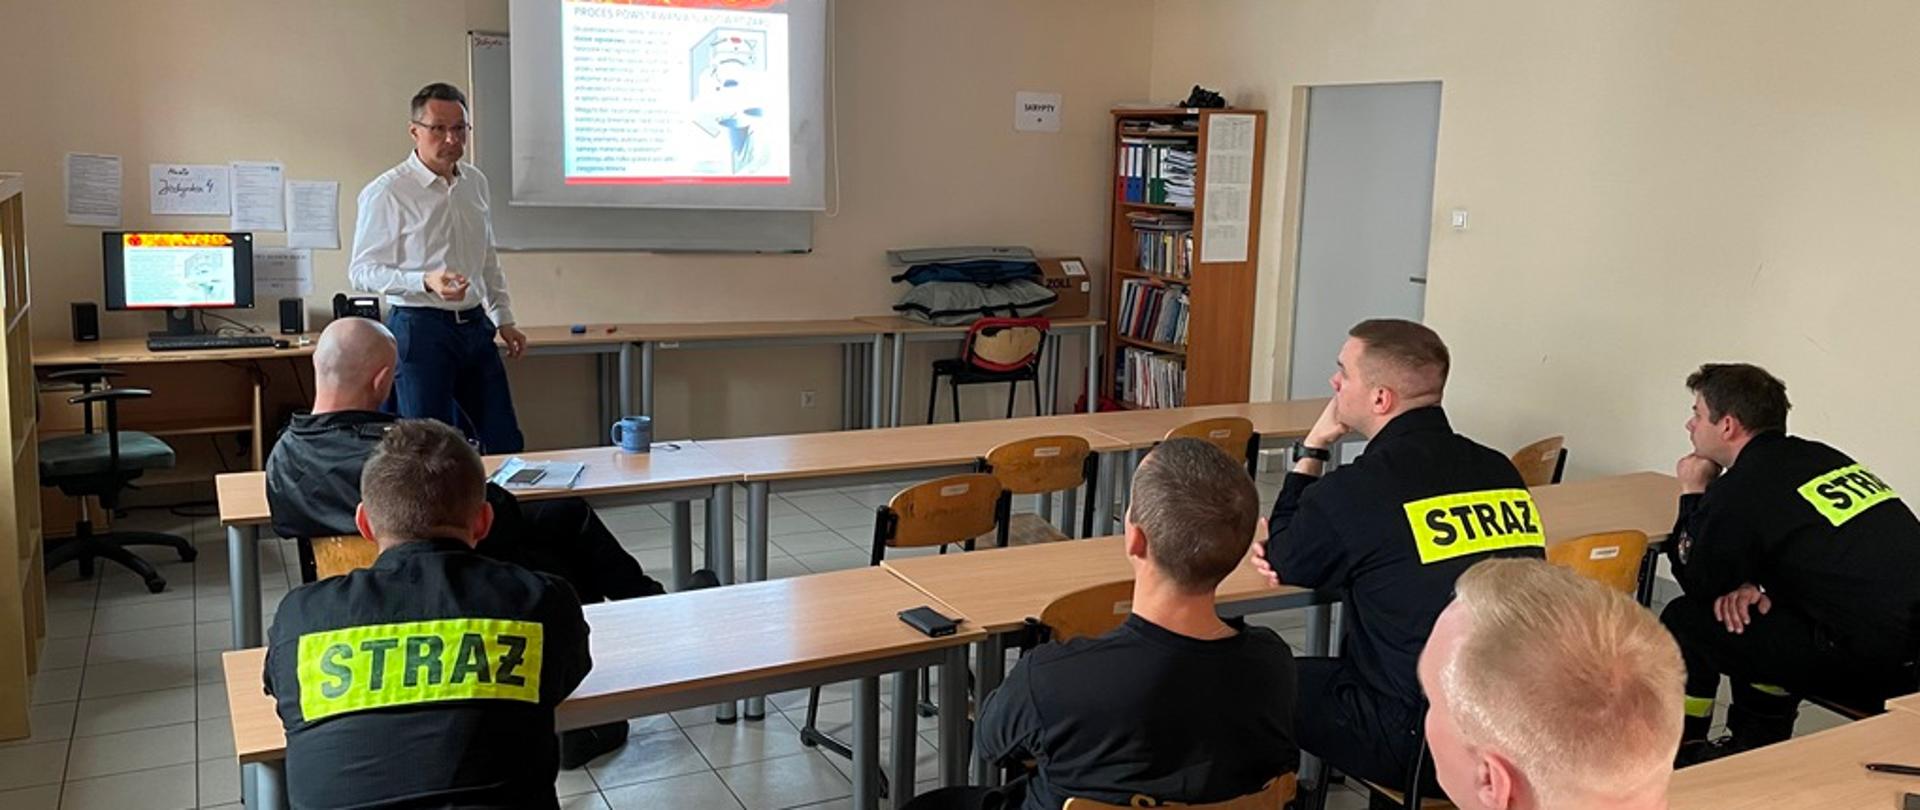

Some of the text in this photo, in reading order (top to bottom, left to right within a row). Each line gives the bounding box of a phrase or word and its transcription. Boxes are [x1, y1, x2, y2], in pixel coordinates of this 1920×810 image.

[1046, 278, 1072, 289] ZOLL
[1816, 469, 1893, 510] STRA
[320, 633, 528, 698] STRAŻ
